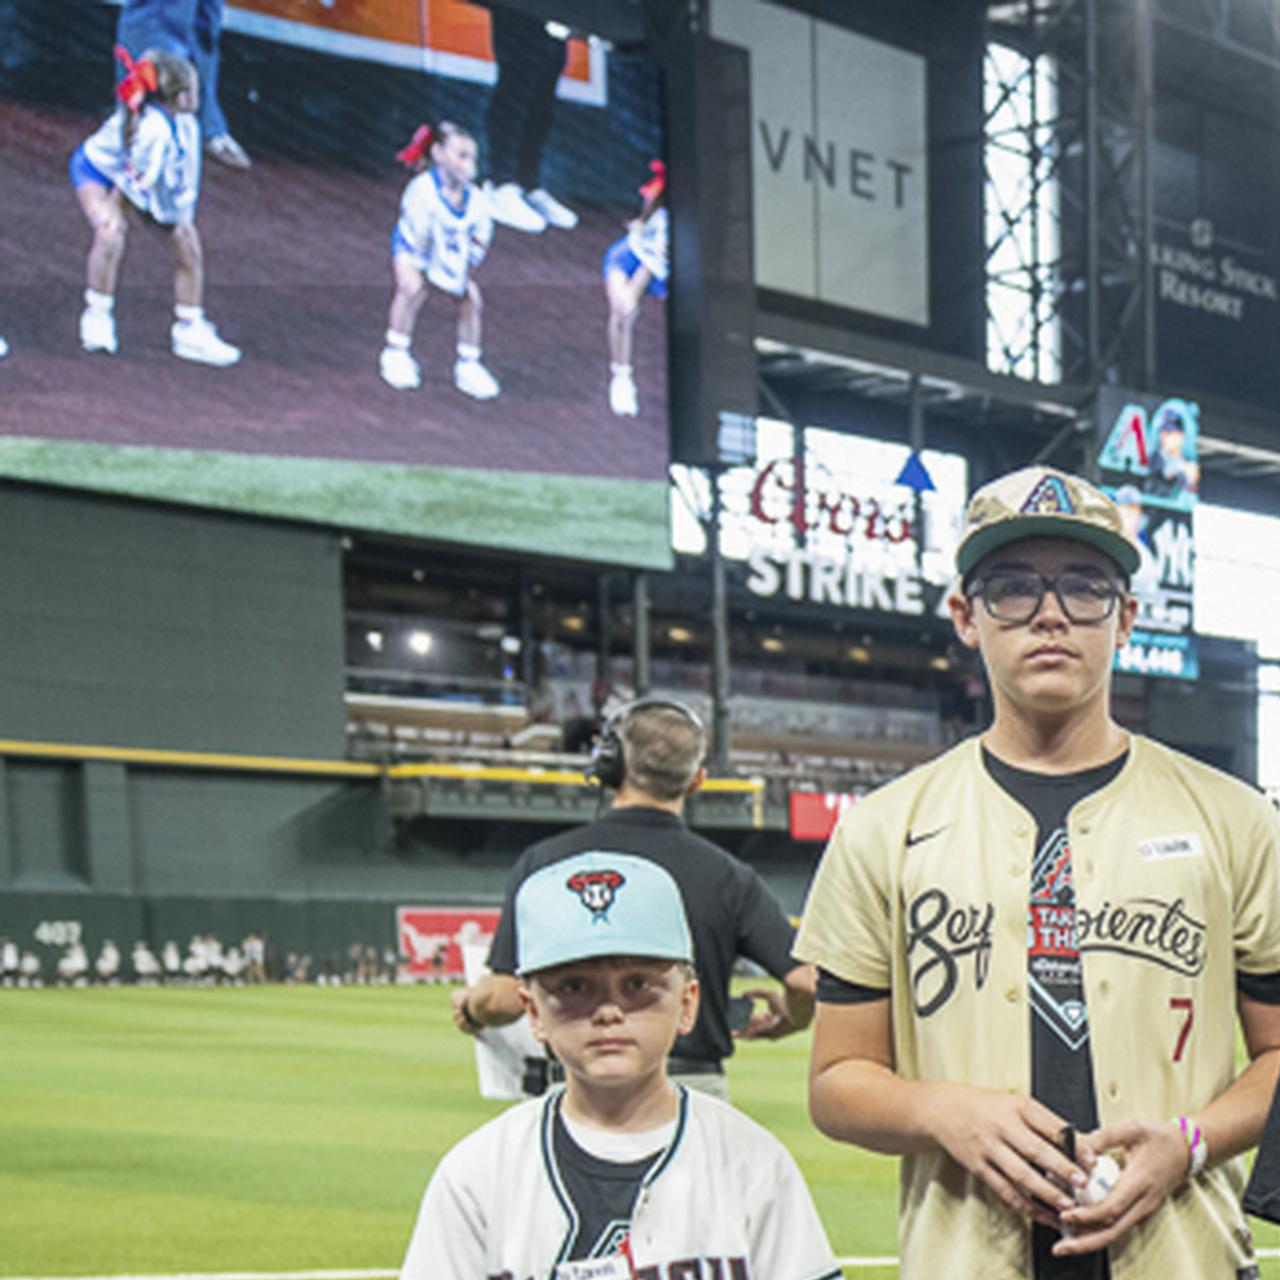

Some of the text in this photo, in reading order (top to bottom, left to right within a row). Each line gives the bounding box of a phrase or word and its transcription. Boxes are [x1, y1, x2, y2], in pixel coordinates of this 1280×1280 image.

[758, 117, 914, 211] VNET
[751, 457, 913, 544] Coors
[747, 548, 926, 616] STRIKE
[1168, 997, 1194, 1062] 7
